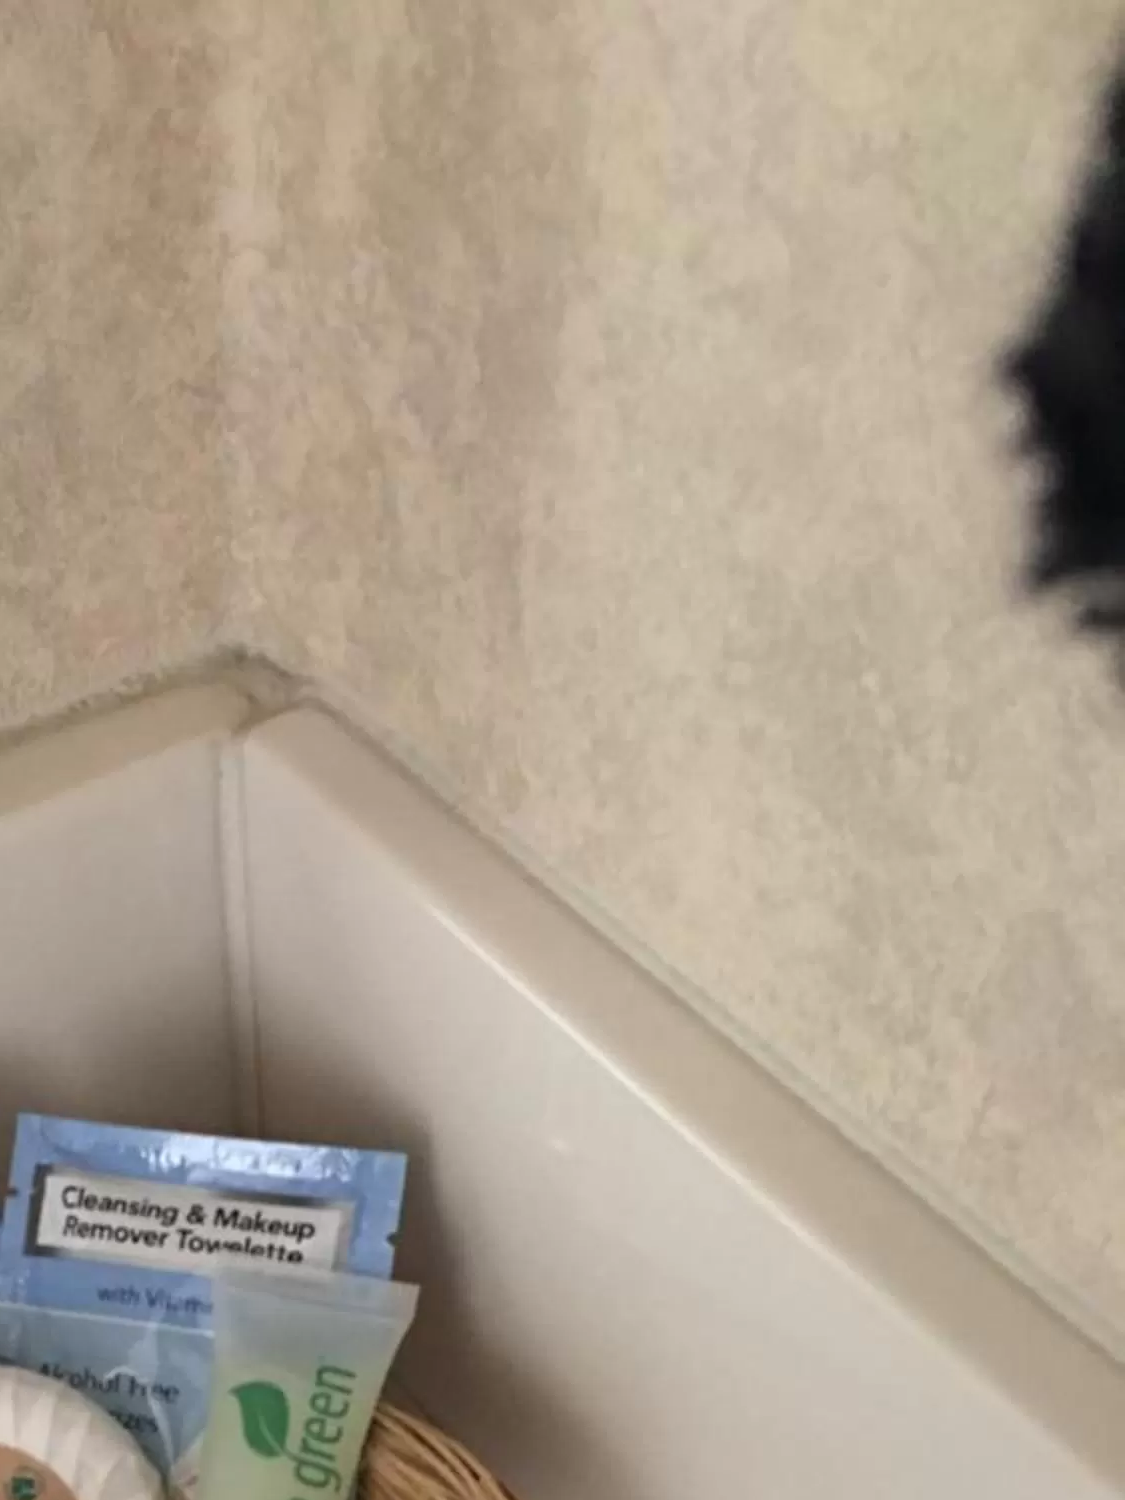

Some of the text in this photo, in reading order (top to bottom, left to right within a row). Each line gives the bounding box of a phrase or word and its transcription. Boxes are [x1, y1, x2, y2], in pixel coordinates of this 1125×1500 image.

[61, 1185, 316, 1244] Cleansing & Makeup
[62, 1214, 305, 1264] Remover Towelette
[97, 1285, 214, 1312] with Vitam
[39, 1362, 120, 1394] Alohol
[294, 1364, 358, 1493] green
